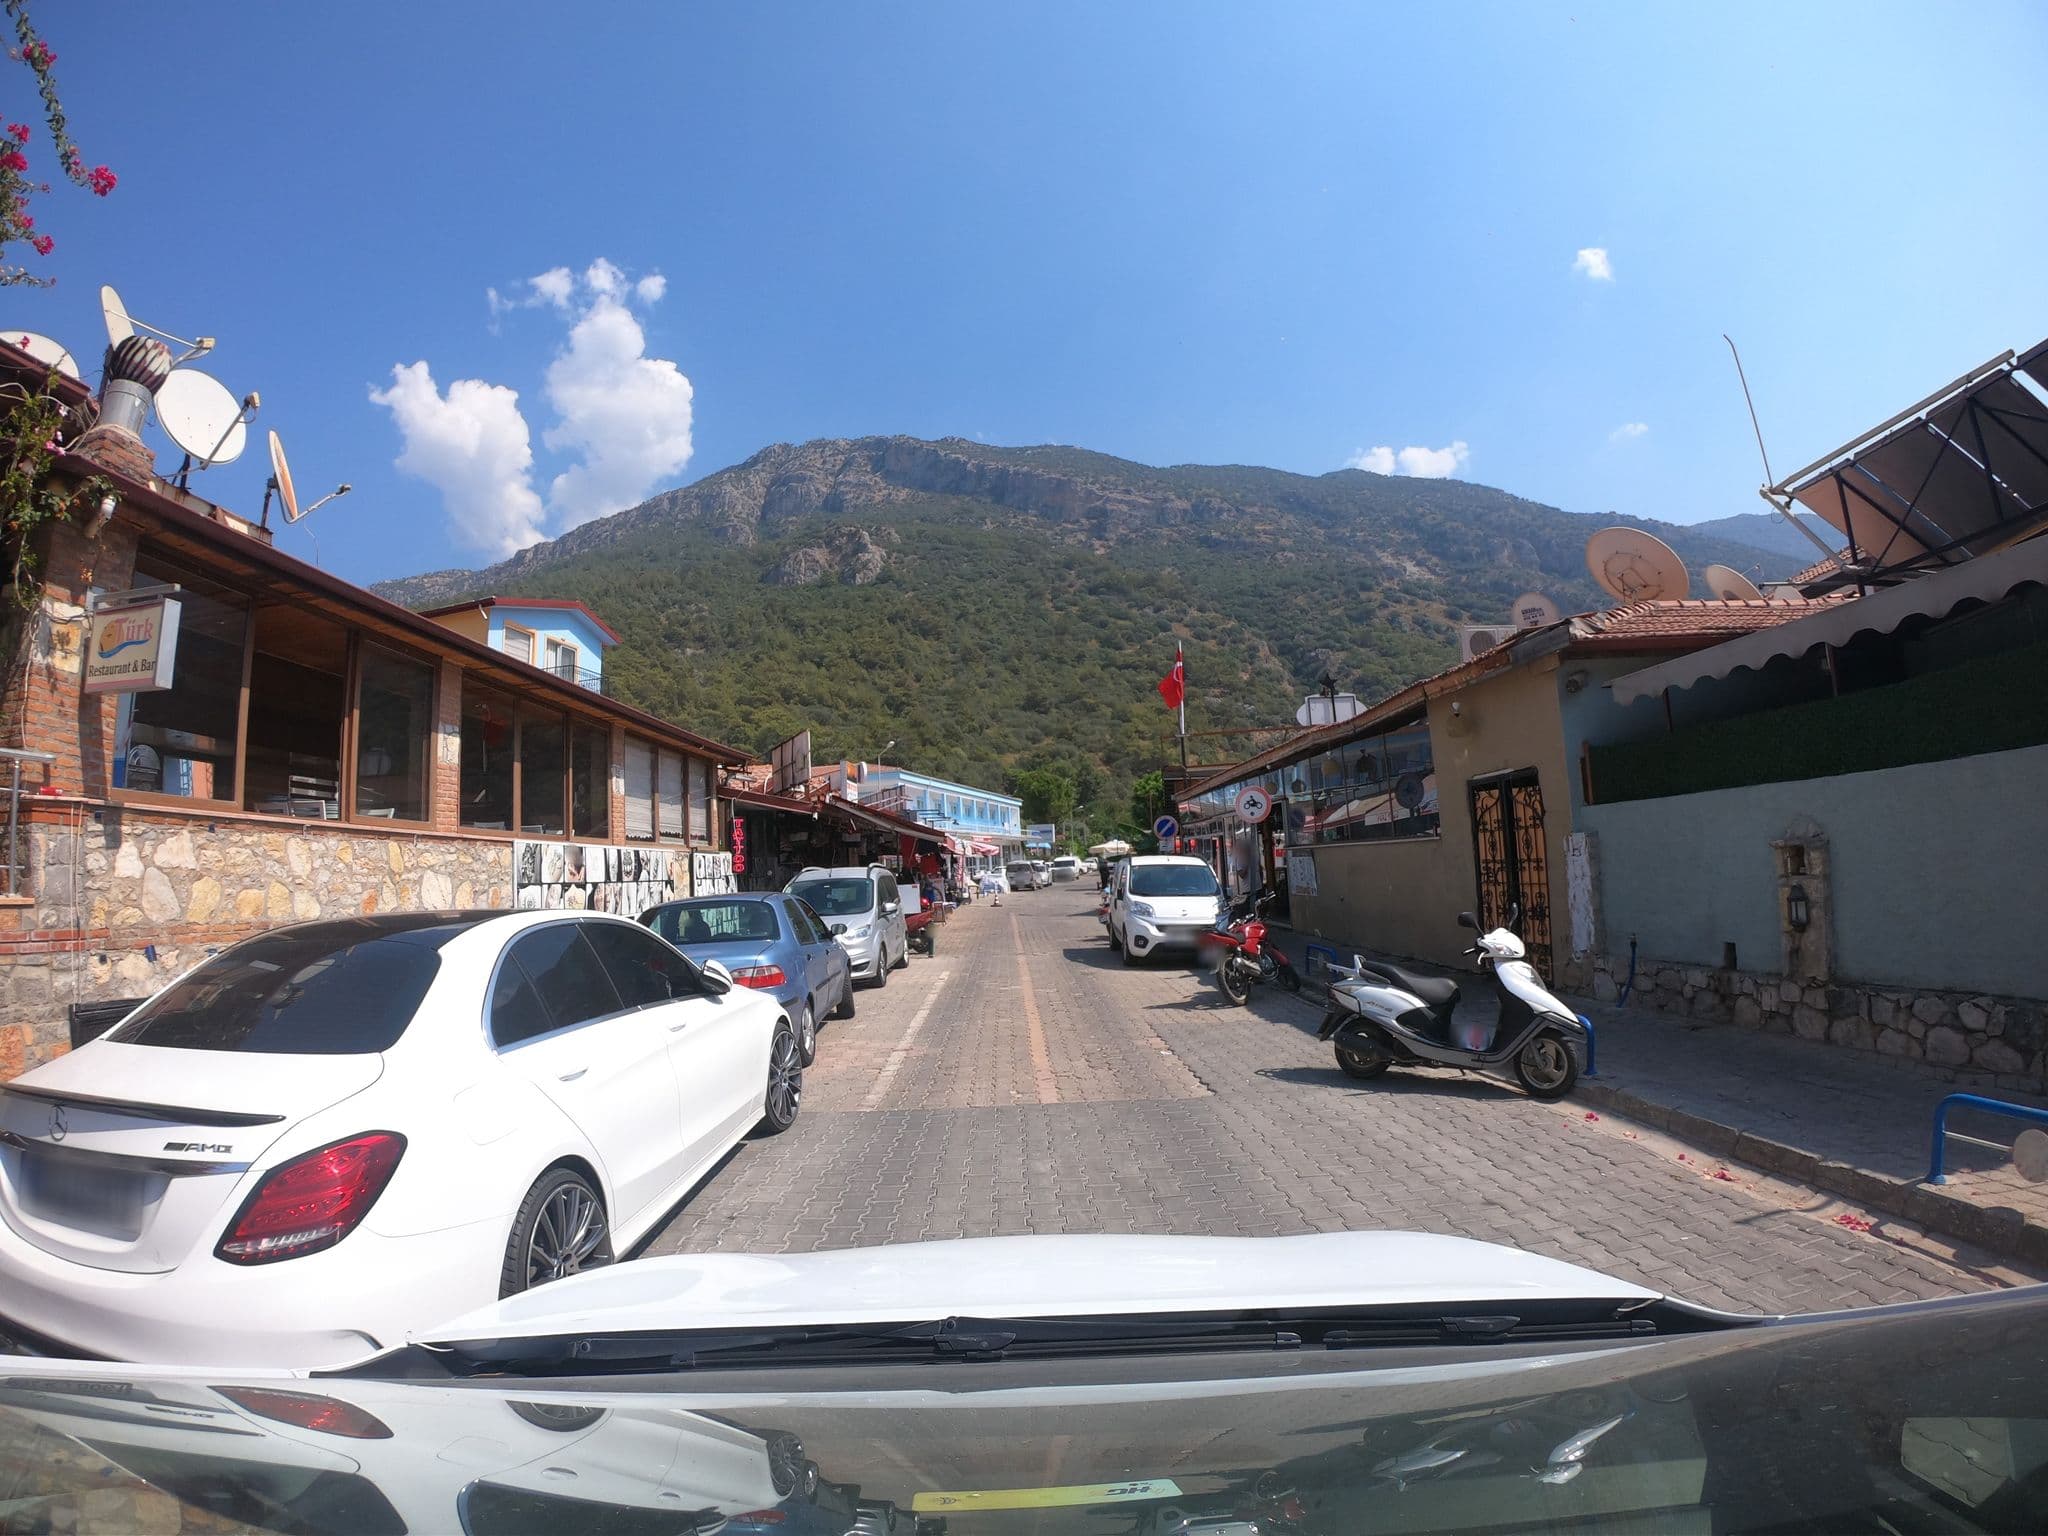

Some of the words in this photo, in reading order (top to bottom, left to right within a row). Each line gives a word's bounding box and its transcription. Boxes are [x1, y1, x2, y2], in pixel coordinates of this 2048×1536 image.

[114, 617, 154, 641] Türk
[88, 663, 131, 677] Restaurant
[132, 660, 138, 672] &
[140, 659, 157, 672] Bar
[184, 1143, 232, 1153] AMG
